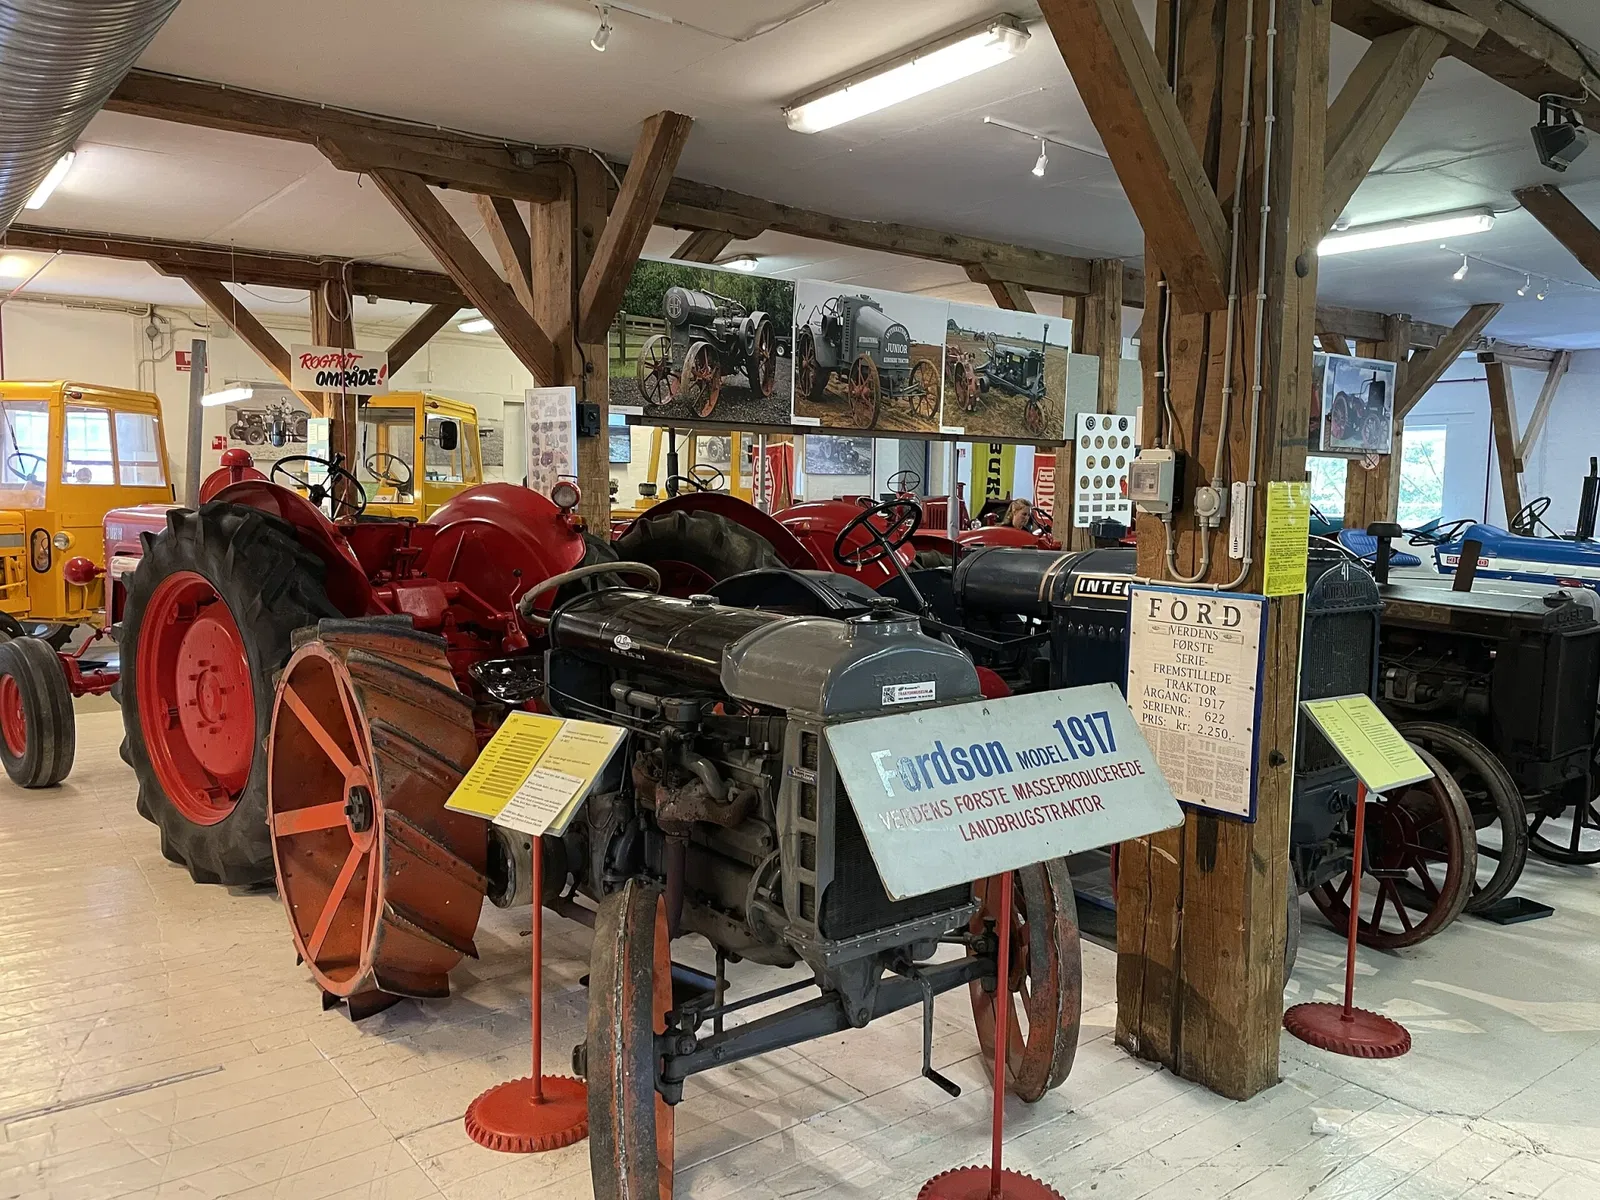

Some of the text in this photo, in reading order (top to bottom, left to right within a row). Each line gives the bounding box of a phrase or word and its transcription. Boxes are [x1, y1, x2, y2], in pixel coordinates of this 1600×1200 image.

[885, 343, 908, 354] JUNIOR
[315, 364, 387, 388] OMRÅDE!
[1148, 597, 1241, 628] FORD
[1170, 625, 1218, 640] VERDENS
[1173, 639, 1214, 654] FØRSTE
[1176, 653, 1208, 667] SERIE-
[1153, 663, 1232, 685] FREMSTILLEDE
[1165, 679, 1217, 697] TRAKTOR
[1142, 699, 1226, 725] SERIENR.: 622
[1198, 696, 1226, 710] 1917
[1142, 712, 1166, 727] PRIS:
[1176, 719, 1191, 732] kr:
[871, 710, 1117, 798] Fordson MODEL 1917
[879, 759, 1146, 830] VERDENS FØRSTE MASSEPRODUCEREDE
[959, 794, 1106, 842] LANDBRUGSTRAKTOR
